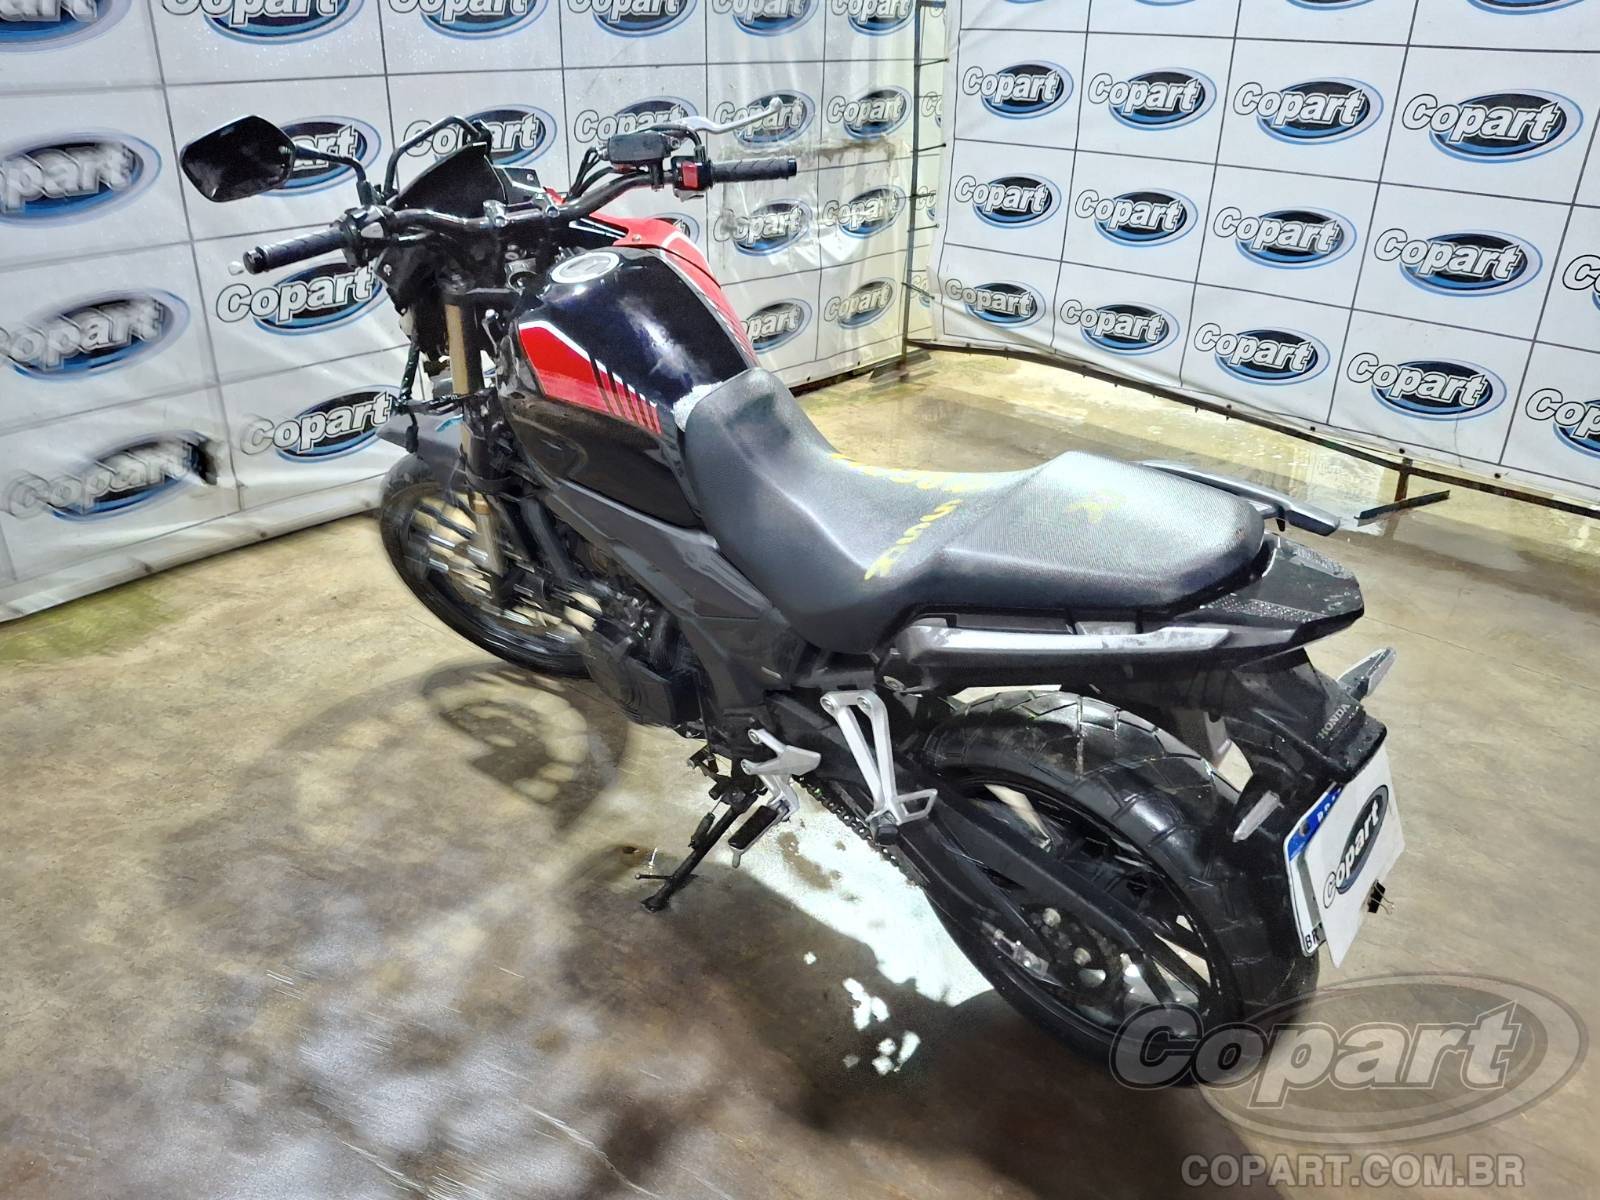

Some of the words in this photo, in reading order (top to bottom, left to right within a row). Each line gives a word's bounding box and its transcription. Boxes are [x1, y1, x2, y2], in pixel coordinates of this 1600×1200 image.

[962, 66, 1060, 104] Copart
[1088, 73, 1200, 115] Copart
[1233, 82, 1365, 128] Copart
[827, 94, 904, 130] Copart
[1402, 93, 1559, 143] Copart
[0, 141, 134, 212] part
[955, 175, 1048, 214] Copart
[1075, 189, 1183, 232] Copart
[1213, 206, 1341, 253] Copart
[1373, 228, 1522, 281] Copart
[216, 264, 374, 325] Copart
[824, 281, 893, 323] Copart
[945, 279, 1034, 319] Copart
[0, 297, 163, 370] opart
[741, 304, 801, 342] part
[1060, 299, 1166, 343] Copart
[1194, 323, 1316, 372] Copart
[1347, 352, 1489, 407] Copart
[240, 392, 393, 455] Copart
[1317, 703, 1350, 740] HONDA
[1323, 799, 1381, 909] Copart
